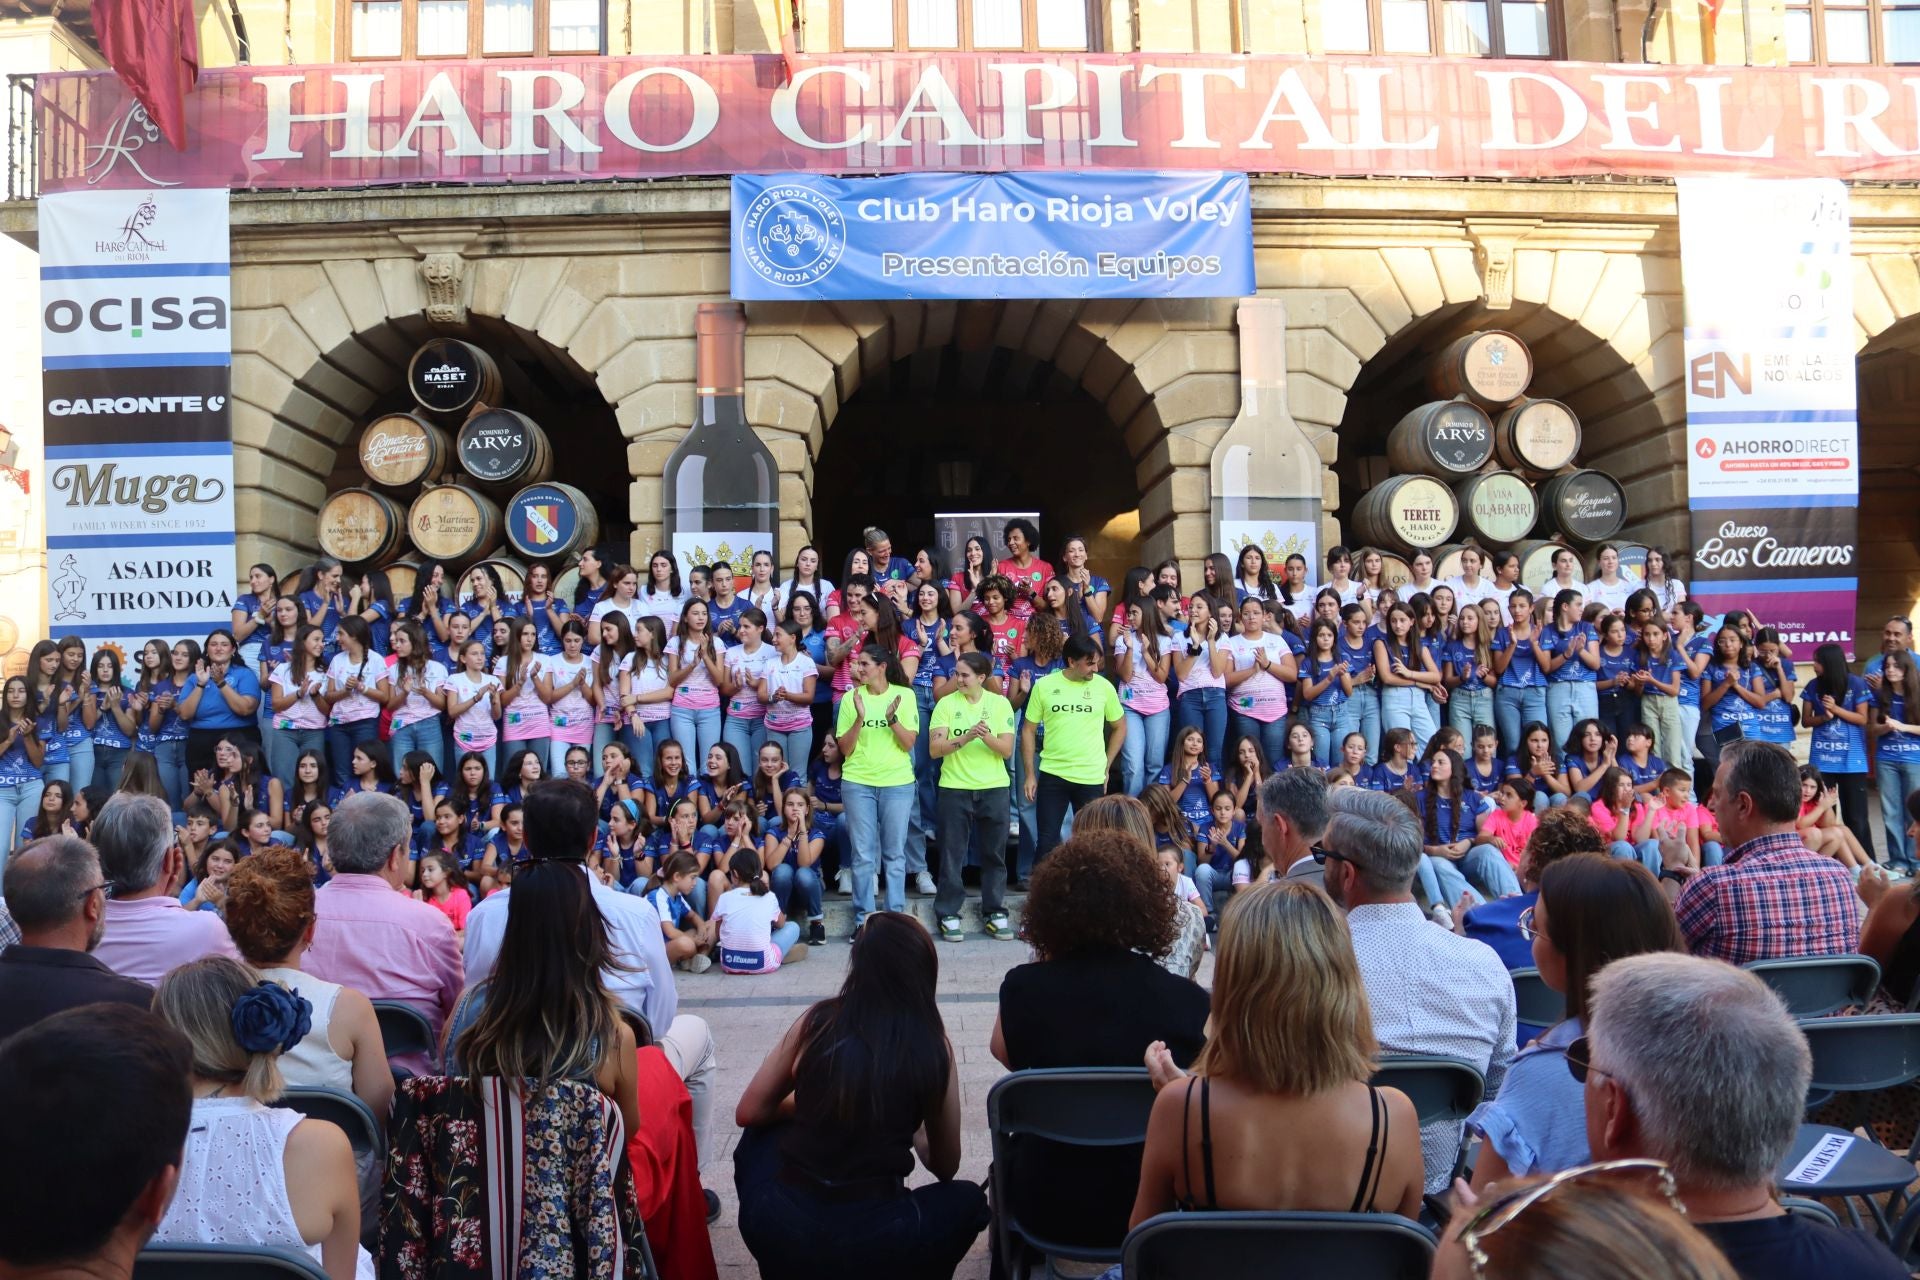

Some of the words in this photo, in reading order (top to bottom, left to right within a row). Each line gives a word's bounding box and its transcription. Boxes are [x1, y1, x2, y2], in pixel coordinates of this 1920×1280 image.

[250, 66, 721, 161] HARO
[770, 62, 1439, 152] CAPITAL
[1474, 70, 1775, 160] DEL
[747, 197, 771, 228] HARO
[772, 189, 808, 200] RIOJA
[811, 195, 840, 227] VOLEY
[857, 196, 941, 222] Club
[952, 196, 1036, 223] Haro
[1047, 194, 1134, 228] Rioja
[1142, 194, 1238, 228] Voley
[127, 253, 150, 262] RIOJA
[747, 246, 772, 275] HARO
[773, 271, 810, 282] RIOJA
[811, 244, 840, 276] VOLEY
[882, 249, 1089, 278] Presentación
[1097, 249, 1222, 282] Equipos
[424, 372, 467, 382] MASET
[1691, 351, 1753, 400] EN
[1764, 369, 1843, 382] NOVALGOS
[48, 396, 203, 416] CARONTE
[1722, 439, 1850, 455] AHORRODIRECT
[52, 463, 227, 515] Muga
[1403, 509, 1441, 521] TERETE
[1475, 503, 1531, 518] OLABARRI
[72, 521, 106, 531] FAMILY
[110, 520, 147, 530] WINERY
[151, 519, 181, 529] SINCE
[1410, 523, 1436, 531] HARO
[1718, 520, 1768, 539] Queso
[1694, 538, 1749, 570] Los
[1752, 536, 1854, 569] Cameros
[107, 559, 214, 580] ASADOR
[67, 580, 80, 595] T
[91, 589, 232, 611] TIRONDOA
[1778, 630, 1852, 644] DENTAL
[1051, 703, 1093, 714] ocisa
[93, 737, 121, 749] cisa
